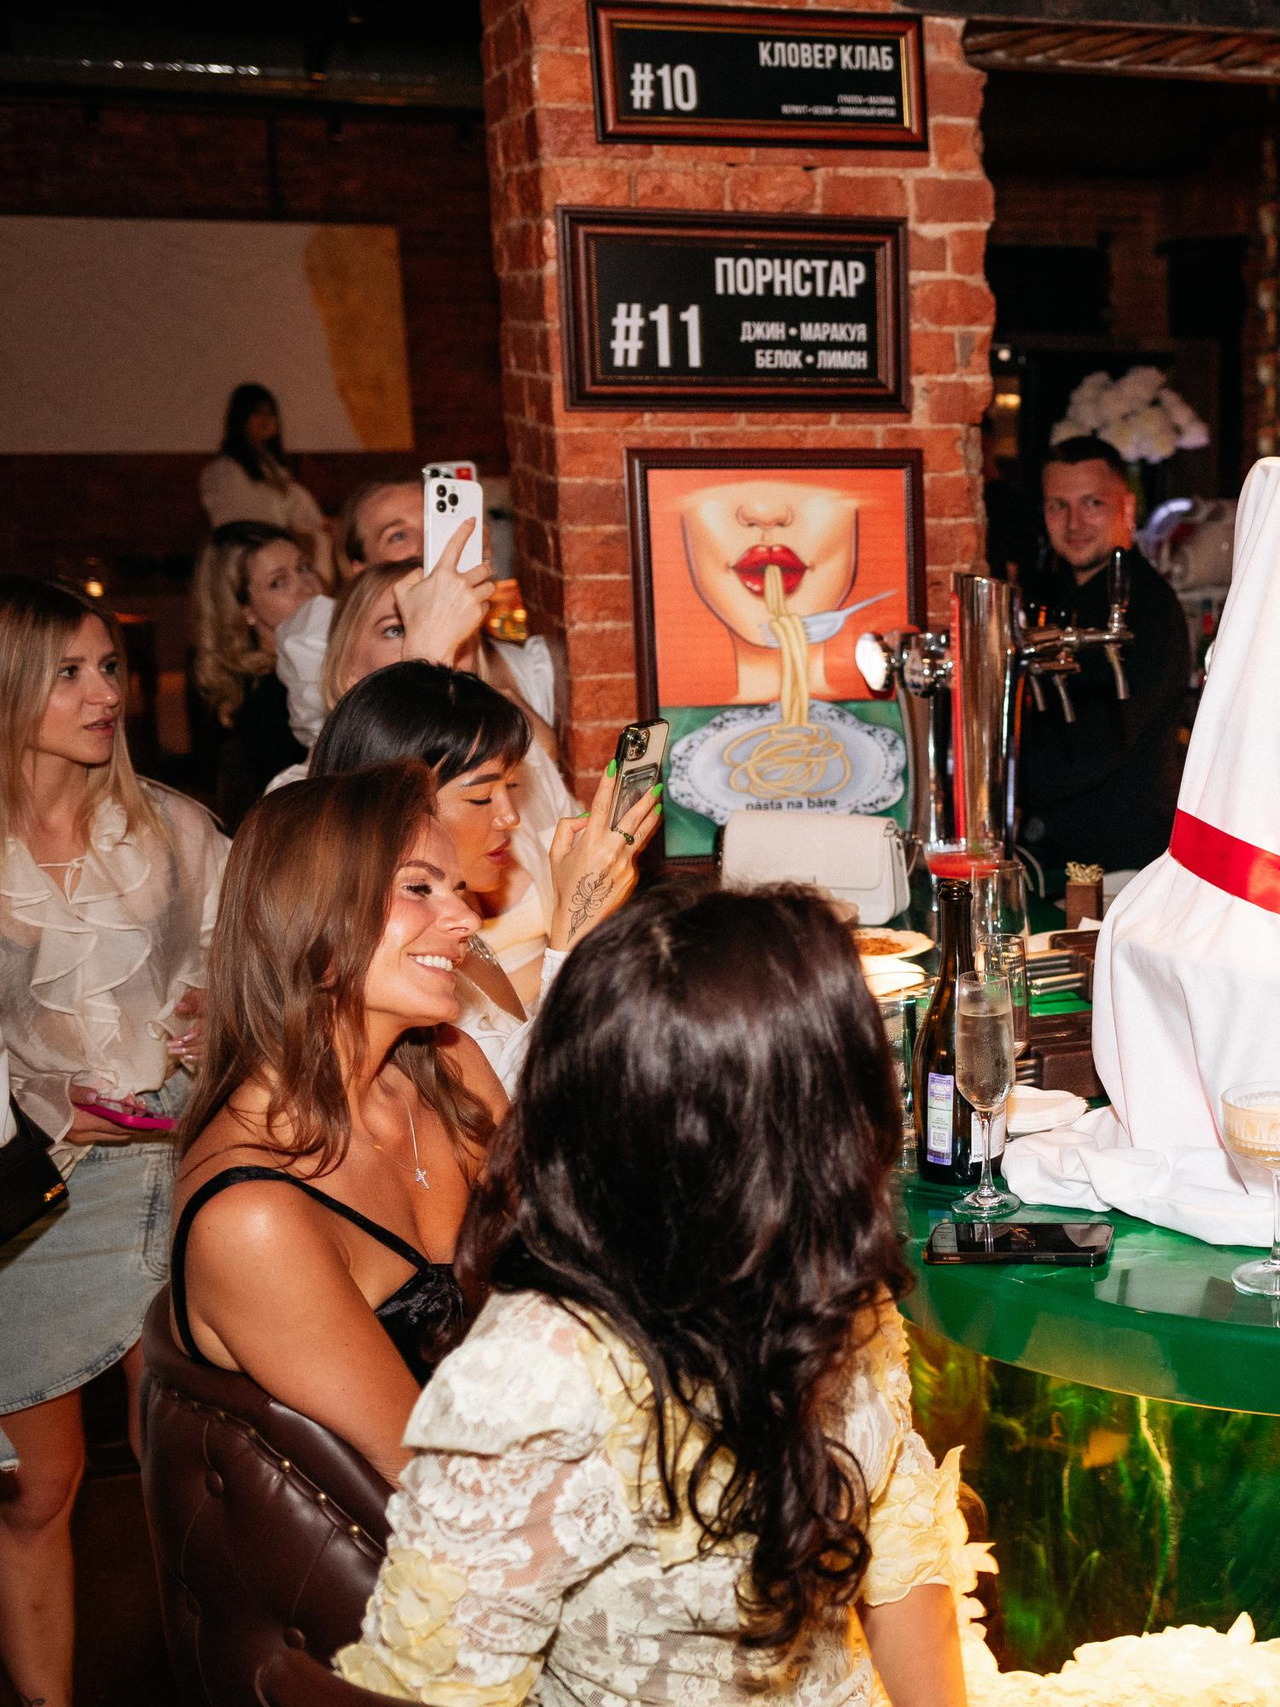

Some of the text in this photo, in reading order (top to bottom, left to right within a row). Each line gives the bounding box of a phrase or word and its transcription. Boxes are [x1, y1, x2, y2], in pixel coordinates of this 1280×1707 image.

[759, 42, 893, 71] КЛОВЕР КЛАБ
[630, 63, 697, 111] #10
[715, 257, 865, 297] ПОРНСТАР
[610, 303, 701, 367] #11
[740, 321, 867, 342] ДЖИН МАРАКУЯ
[755, 349, 867, 369] БЕЛОК ЛИМОН
